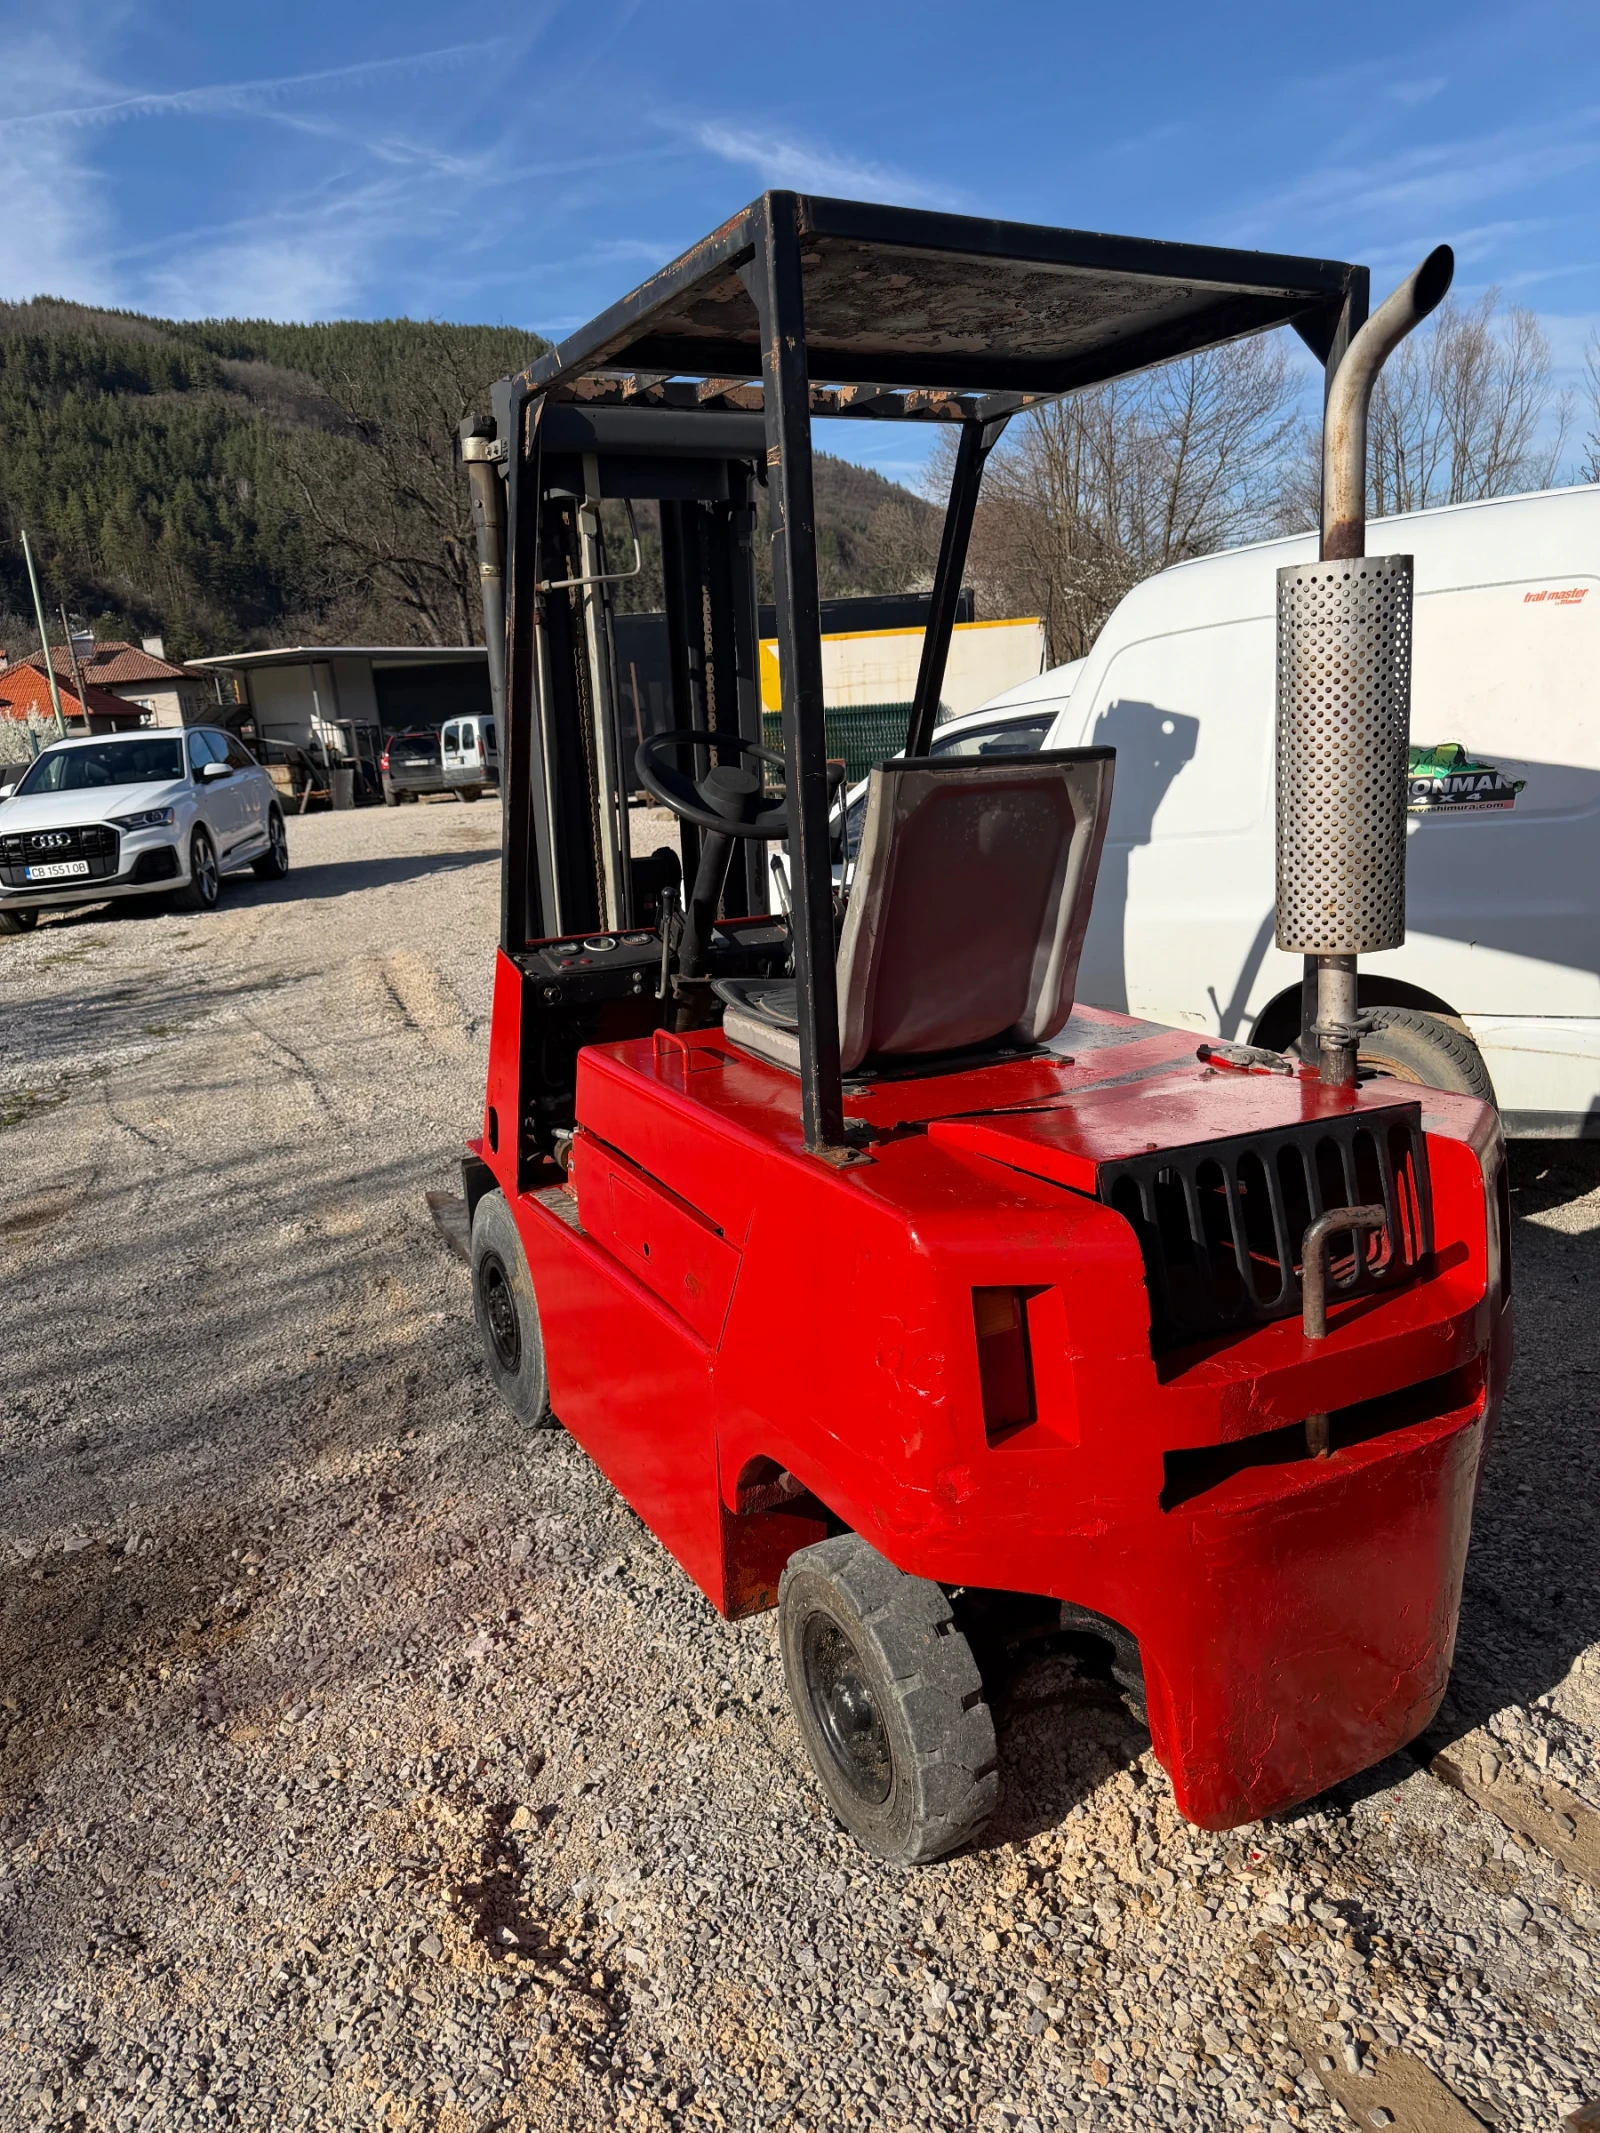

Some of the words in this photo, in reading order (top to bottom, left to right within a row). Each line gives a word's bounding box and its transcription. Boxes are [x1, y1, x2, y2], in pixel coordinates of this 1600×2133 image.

[1523, 591, 1548, 603] trail
[1547, 588, 1589, 601] master
[1413, 796, 1428, 804] 4
[1466, 793, 1481, 801] 4
[31, 867, 46, 878] CB
[47, 864, 71, 876] 1551
